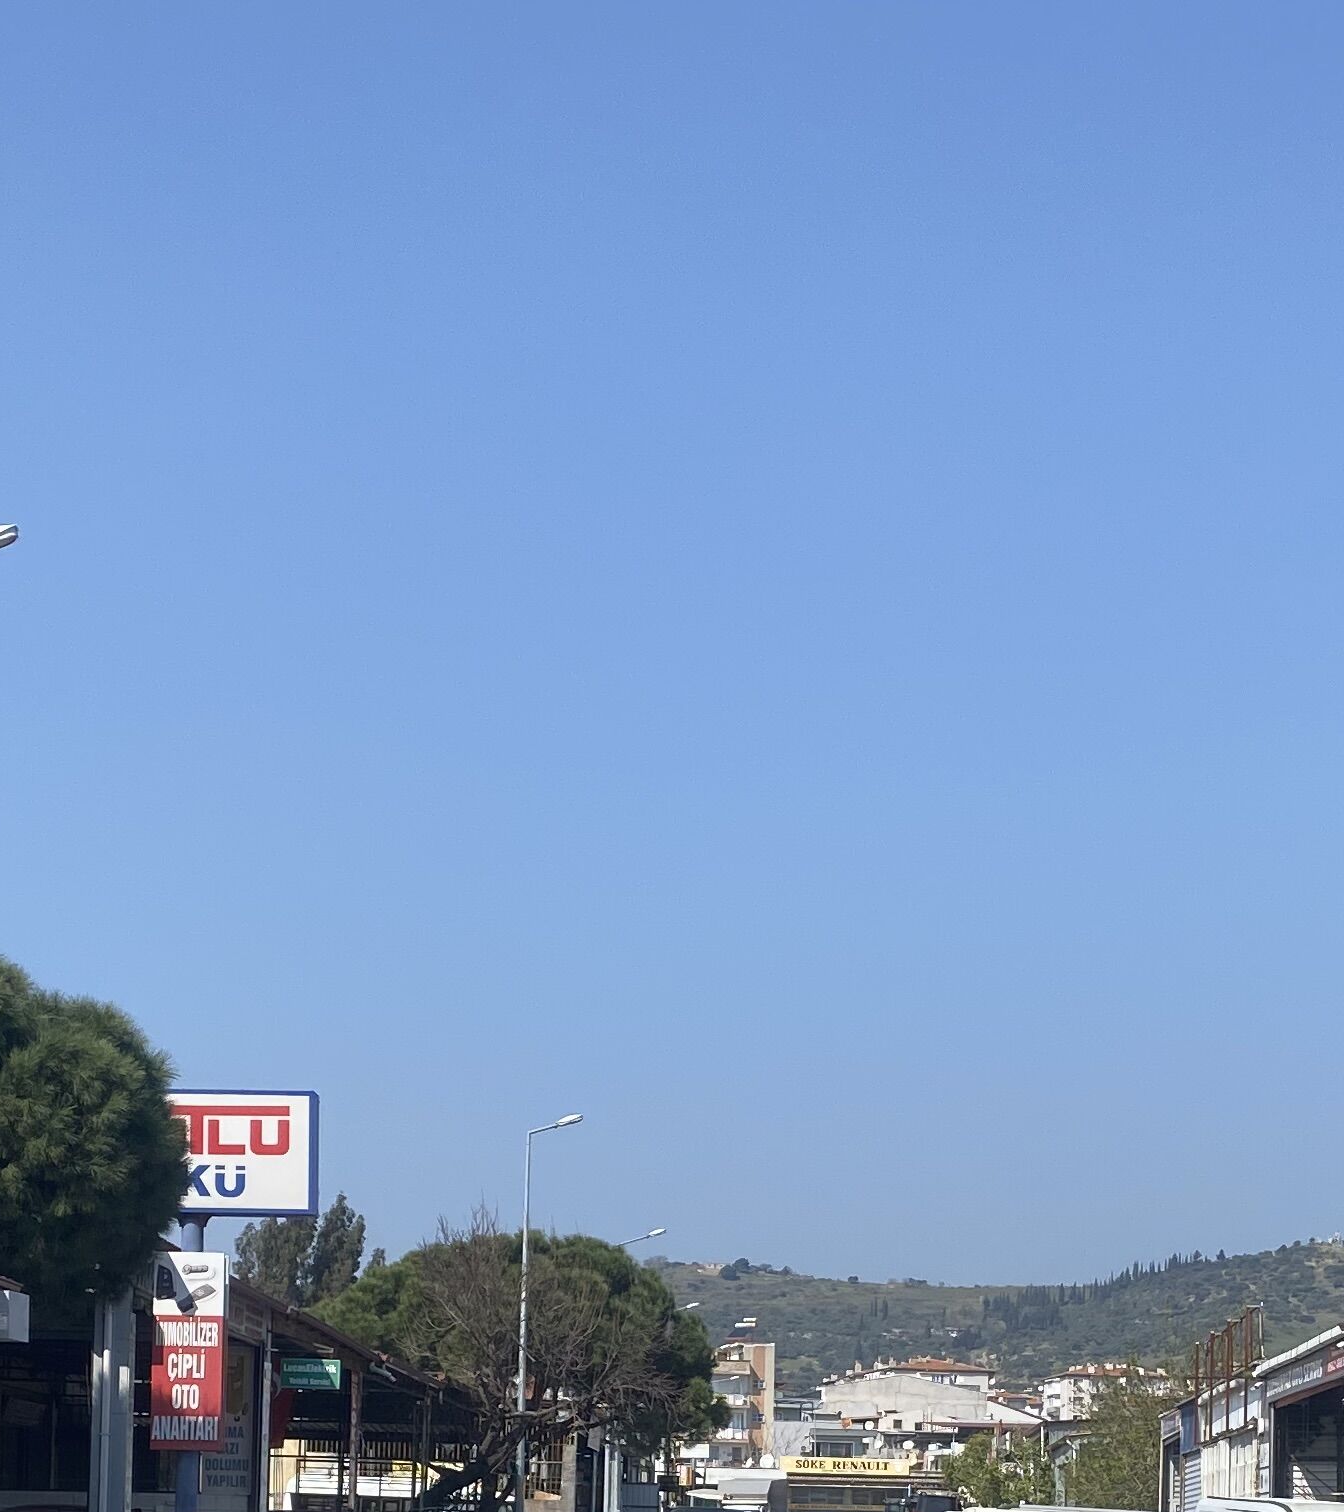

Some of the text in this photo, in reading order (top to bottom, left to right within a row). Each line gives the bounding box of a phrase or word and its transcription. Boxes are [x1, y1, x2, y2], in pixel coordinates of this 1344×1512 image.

[170, 1105, 290, 1155] TLU
[190, 1165, 246, 1198] KÜ
[156, 1316, 219, 1347] İMMOBİLİZER
[167, 1348, 206, 1382] ÇİPLİ
[171, 1384, 200, 1410] OTO
[151, 1416, 219, 1441] ANAHTARI
[205, 1458, 249, 1472] DOLUMU
[795, 1458, 890, 1471] SÖKE RENAULT
[207, 1474, 247, 1488] YAPILIR
